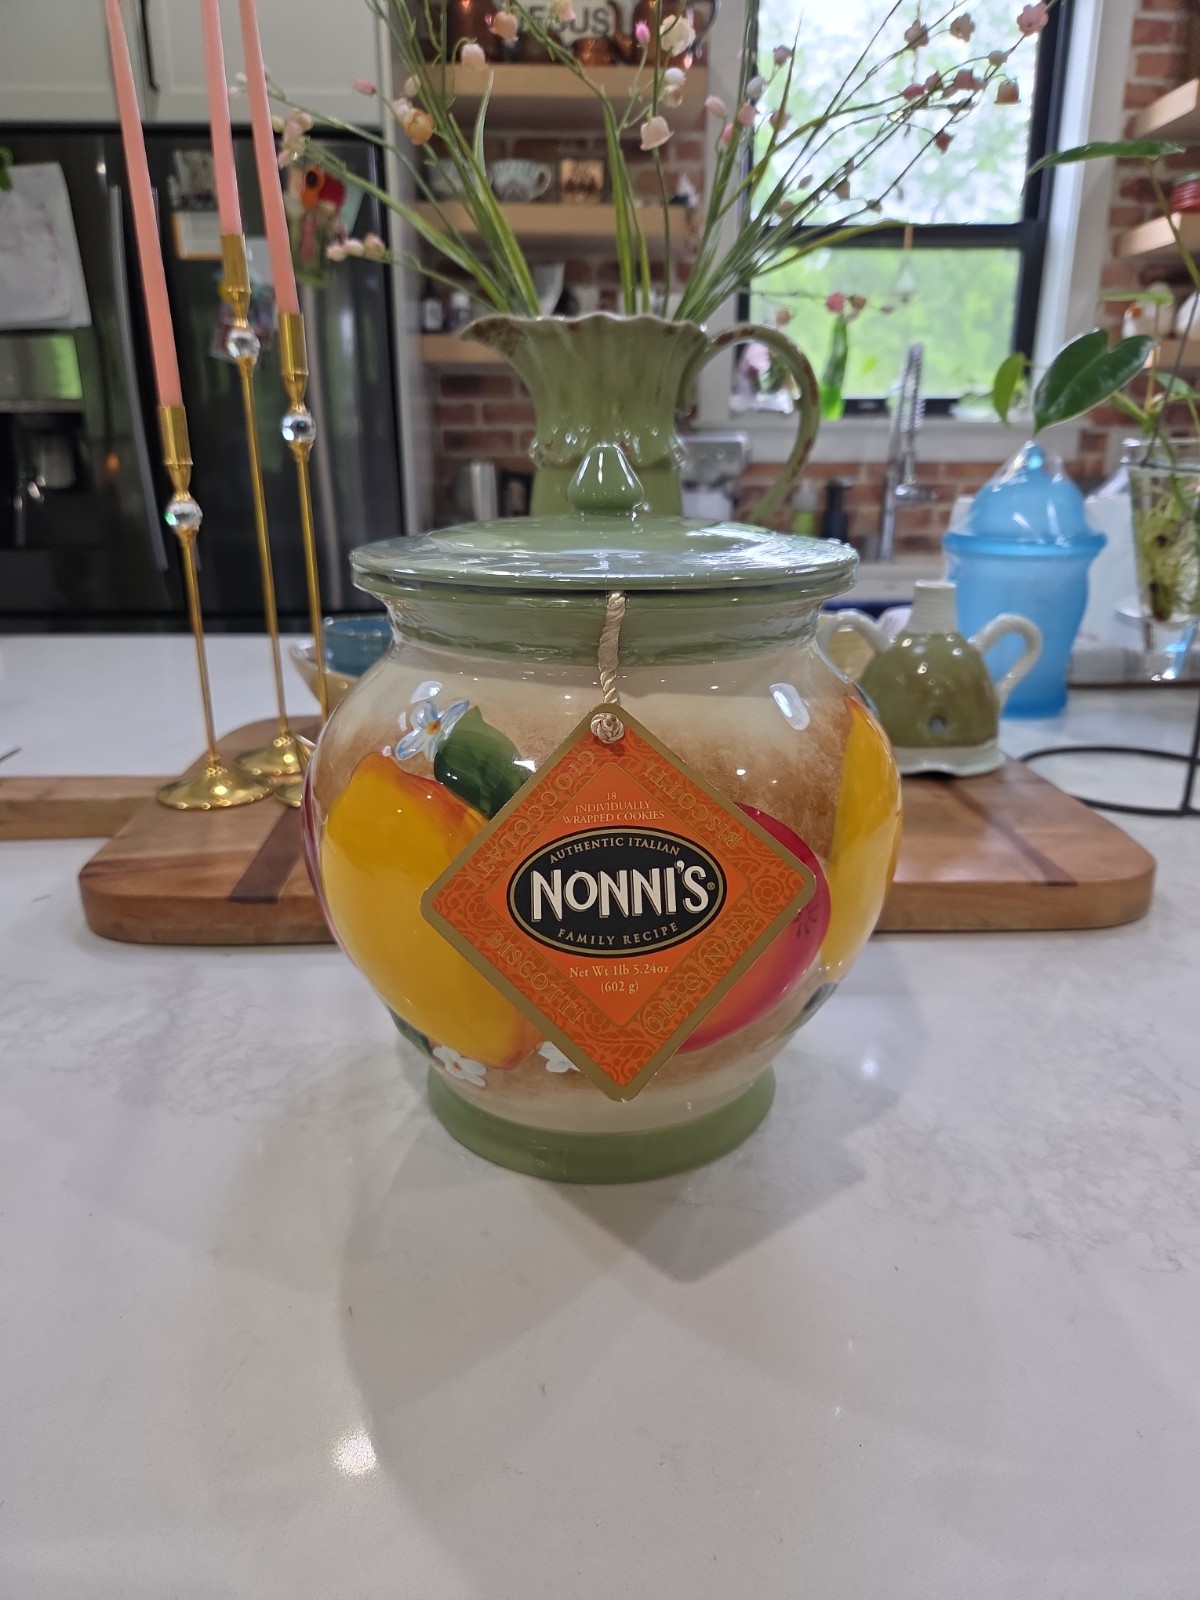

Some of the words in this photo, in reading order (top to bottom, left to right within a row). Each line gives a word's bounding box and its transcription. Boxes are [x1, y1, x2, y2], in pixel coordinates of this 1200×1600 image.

[575, 801, 651, 813] INDIVIDUALLY
[607, 792, 617, 801] 18
[643, 761, 743, 849] BISCOTTI
[466, 750, 595, 887] CIOCCOLATI
[563, 813, 614, 824] WRAPPED
[616, 811, 665, 821] COOKIES
[549, 837, 624, 864] AUTHENTIC
[628, 837, 680, 856] ITALIAN
[530, 860, 709, 923] NONNI'S
[558, 928, 616, 945] FAMILY
[622, 922, 679, 945] RECIPE
[488, 930, 586, 1025] BISCOTTI
[569, 967, 589, 978] Net
[592, 965, 609, 976] Wt
[612, 964, 630, 976] 1lb
[633, 962, 670, 976] 5.24oz
[645, 907, 761, 1034] ORIGINALI
[600, 980, 626, 994] (602
[628, 980, 639, 995] g)
